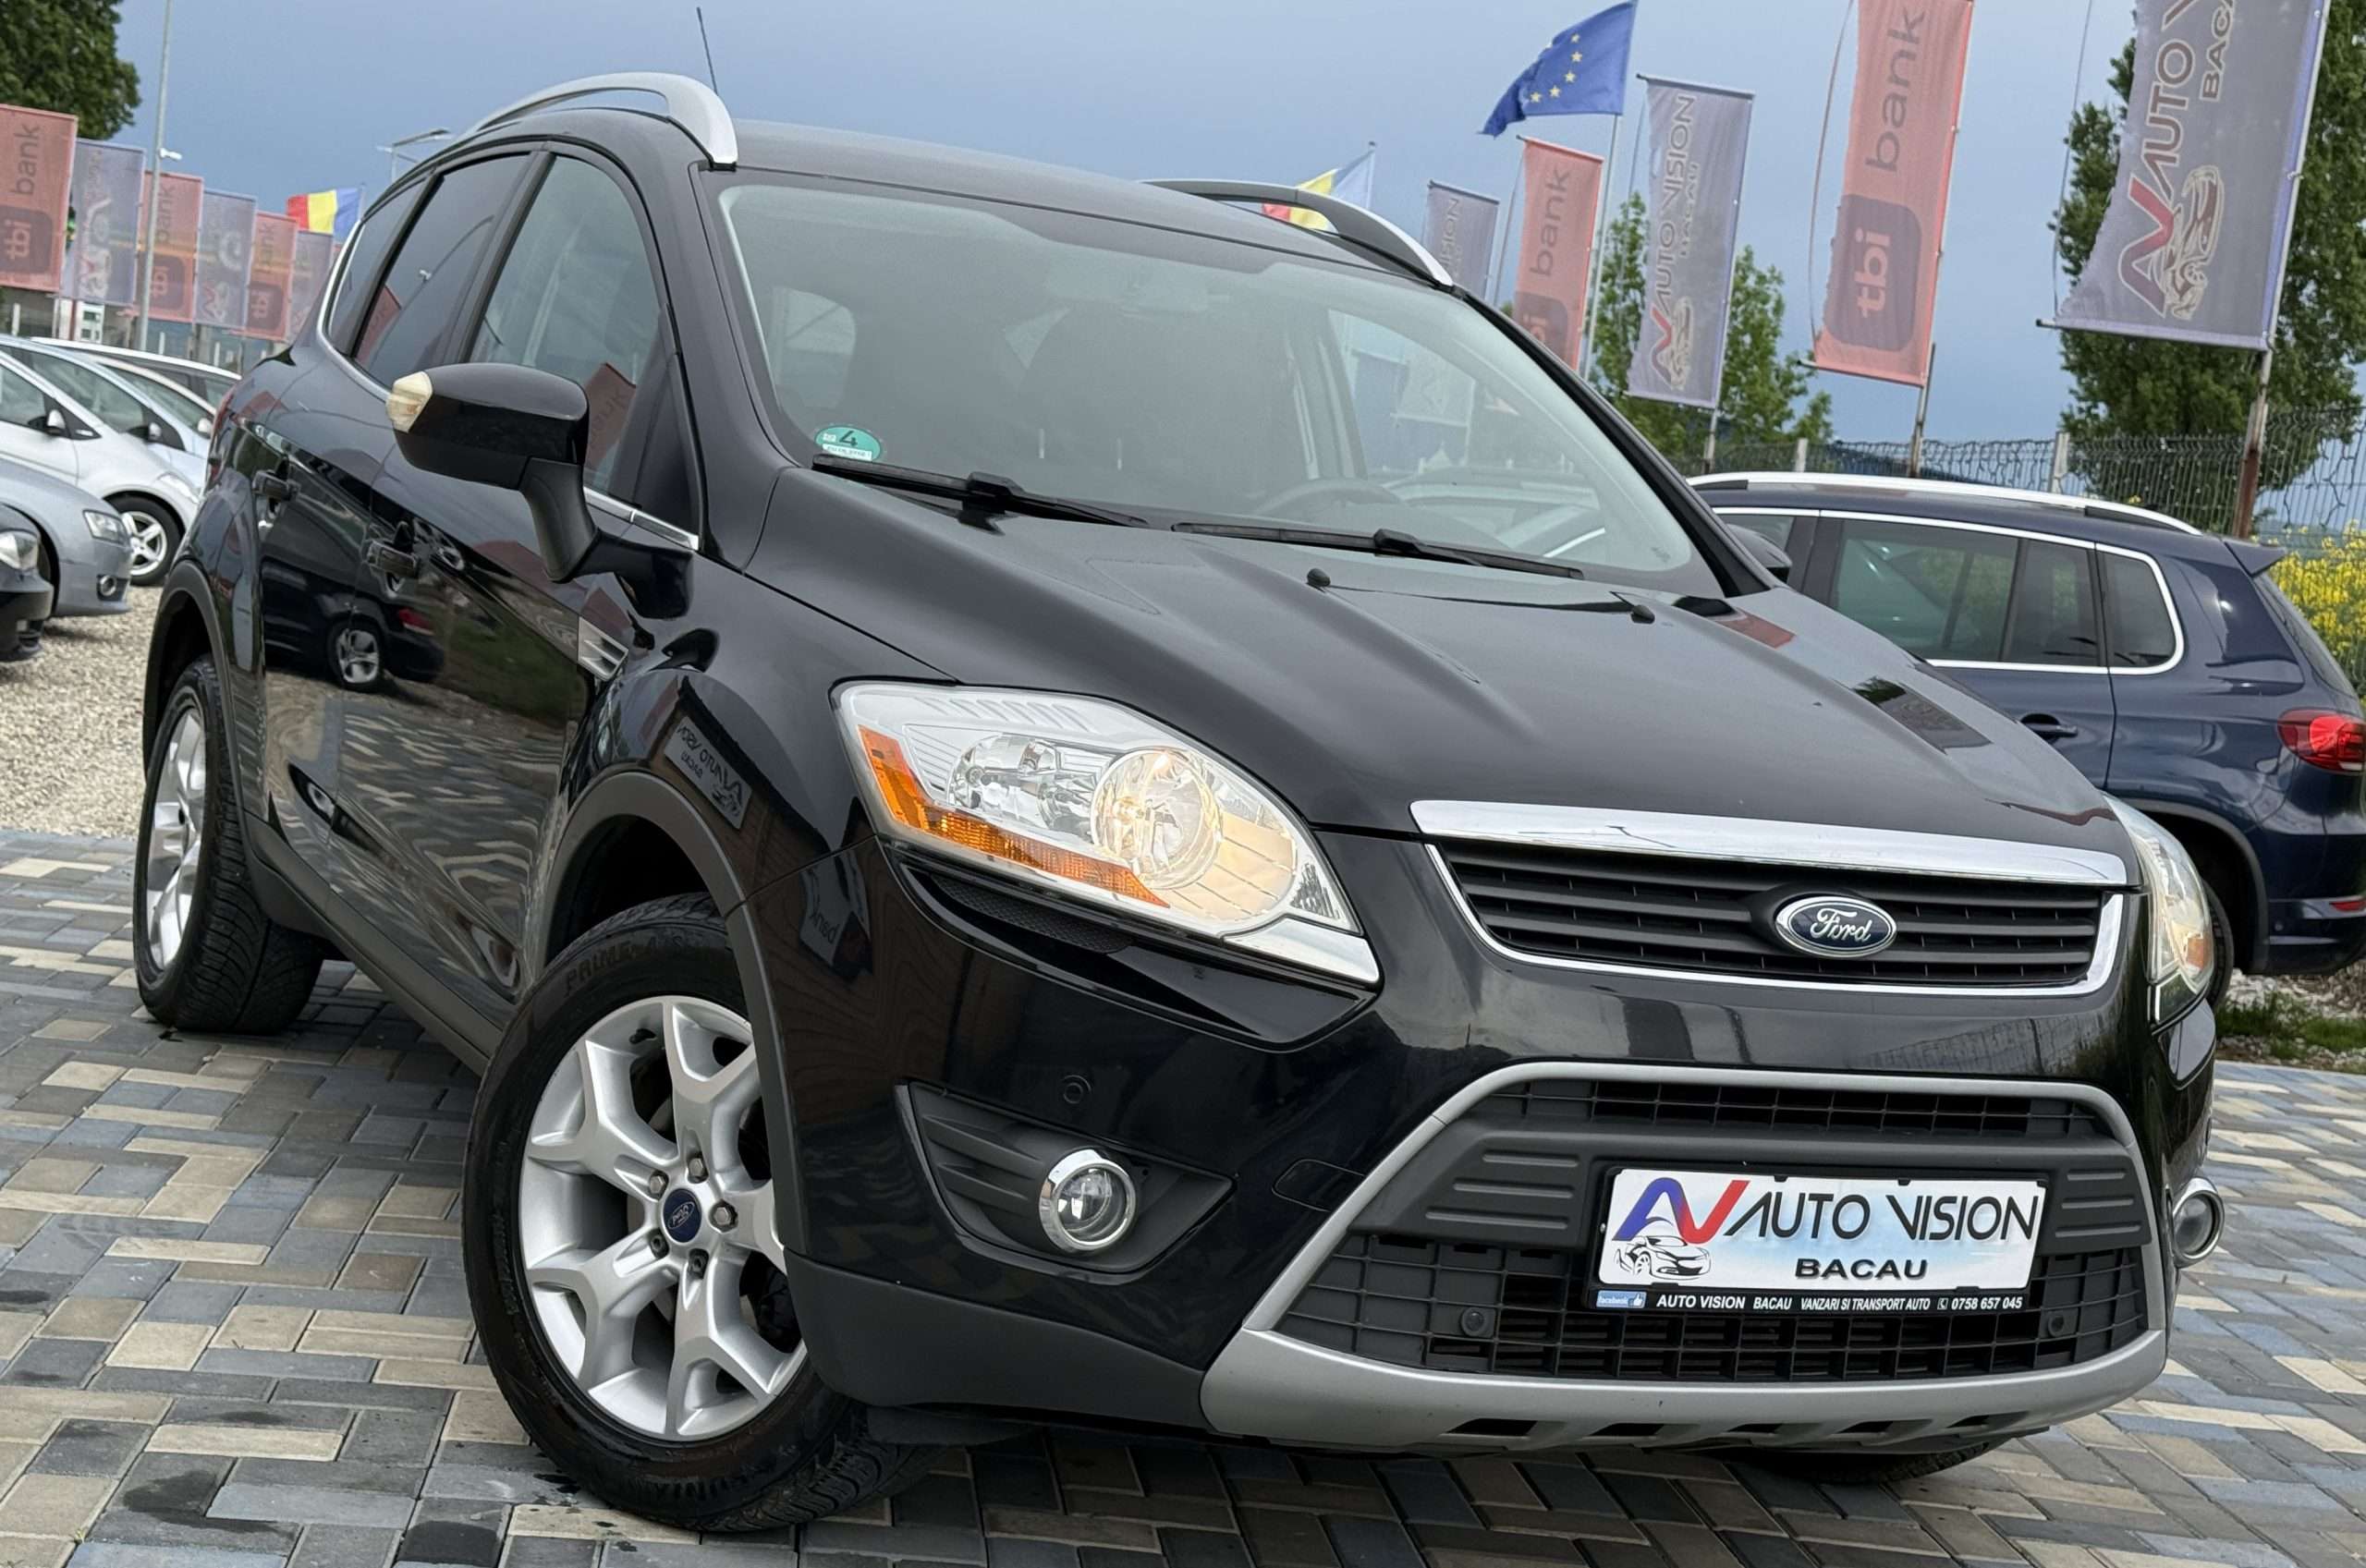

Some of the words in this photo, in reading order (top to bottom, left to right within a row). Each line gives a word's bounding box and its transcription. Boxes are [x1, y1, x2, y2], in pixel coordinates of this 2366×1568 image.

[1865, 7, 1925, 172] bank
[2141, 40, 2195, 203] AUTO
[10, 124, 41, 196] bank
[1661, 94, 1697, 213] VISION
[4, 219, 32, 260] tbi
[1438, 197, 1460, 270] ISION
[1529, 164, 1570, 276] bank
[1655, 222, 1676, 317] AUTO
[1854, 228, 1891, 318] tbi
[838, 430, 859, 447] 4
[1810, 907, 1872, 942] Ford
[1723, 1191, 1872, 1240] AUTO
[1885, 1194, 2039, 1241] VISION
[1656, 1295, 1696, 1308] AUTO
[1700, 1295, 1745, 1309] VISION
[1752, 1296, 1792, 1310] BACAU
[1800, 1297, 1840, 1310] VANZARI
[1841, 1297, 1850, 1310] SI
[1851, 1297, 1905, 1310] TRANSPORT
[1905, 1297, 1931, 1310] AUTO
[1951, 1296, 1978, 1310] 0758
[1980, 1296, 2001, 1310] 657
[2002, 1296, 2022, 1309] 045
[1795, 1258, 1928, 1280] BACAU
